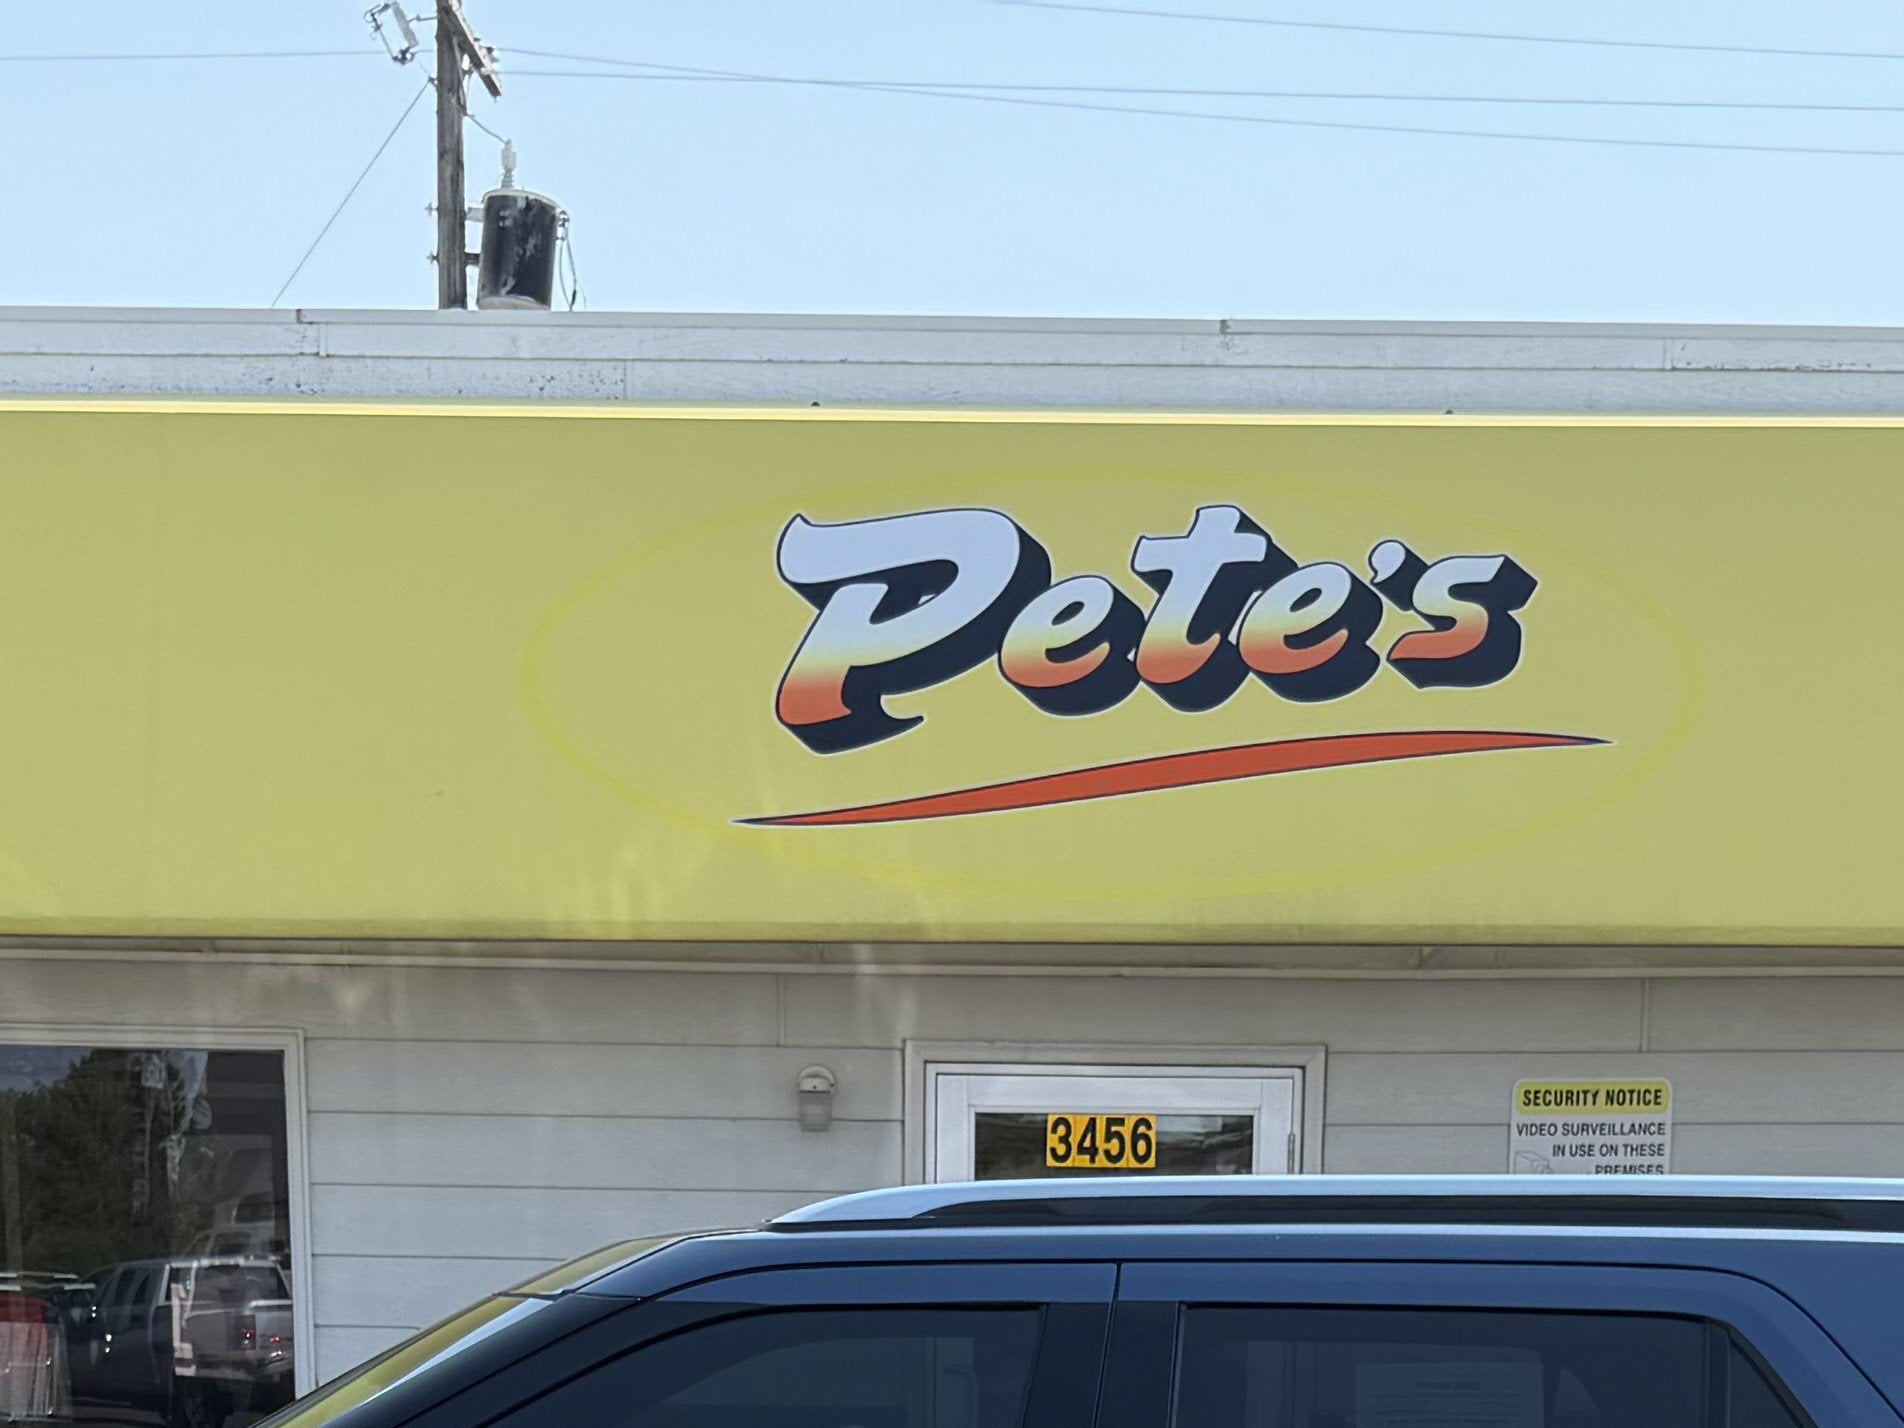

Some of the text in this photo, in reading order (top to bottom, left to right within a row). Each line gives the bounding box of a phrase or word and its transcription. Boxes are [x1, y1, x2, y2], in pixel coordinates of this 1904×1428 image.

[775, 503, 1539, 756] Pete's
[1523, 1089, 1663, 1107] SECURITY NOTICE
[1516, 1123, 1666, 1137] VIDEO SURVEILLANCE
[1050, 1116, 1153, 1165] 3456
[1552, 1143, 1665, 1157] IN USE ON THESE
[1595, 1165, 1664, 1175] PREMISES
